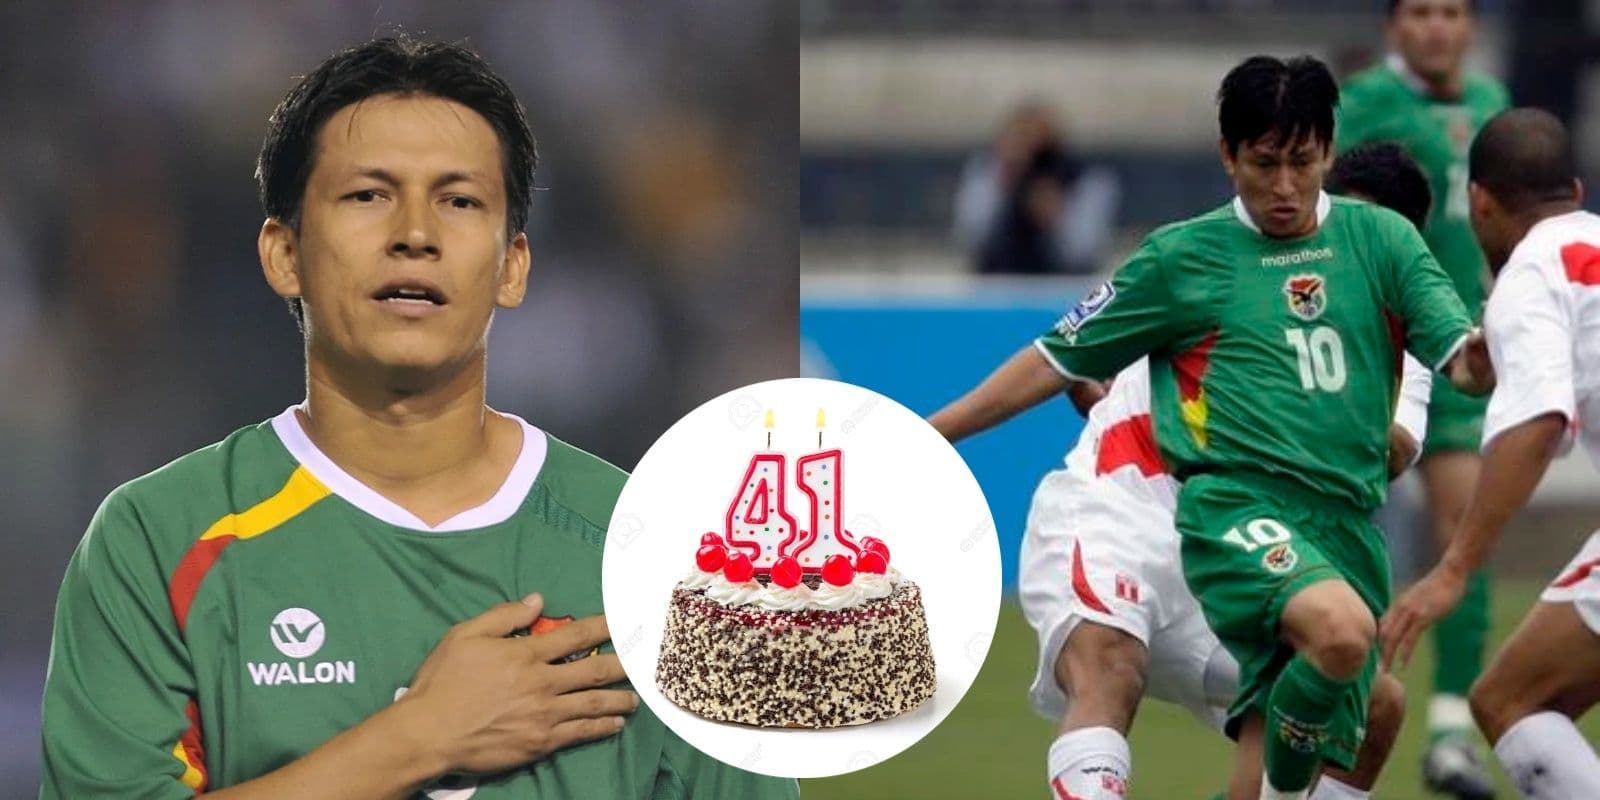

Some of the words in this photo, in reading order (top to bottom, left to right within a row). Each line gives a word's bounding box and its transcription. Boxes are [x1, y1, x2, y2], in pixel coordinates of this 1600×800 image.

[1261, 247, 1334, 268] marathon
[1285, 326, 1346, 393] 10
[725, 449, 863, 574] 41
[1222, 518, 1291, 553] 10
[246, 660, 356, 686] WALON
